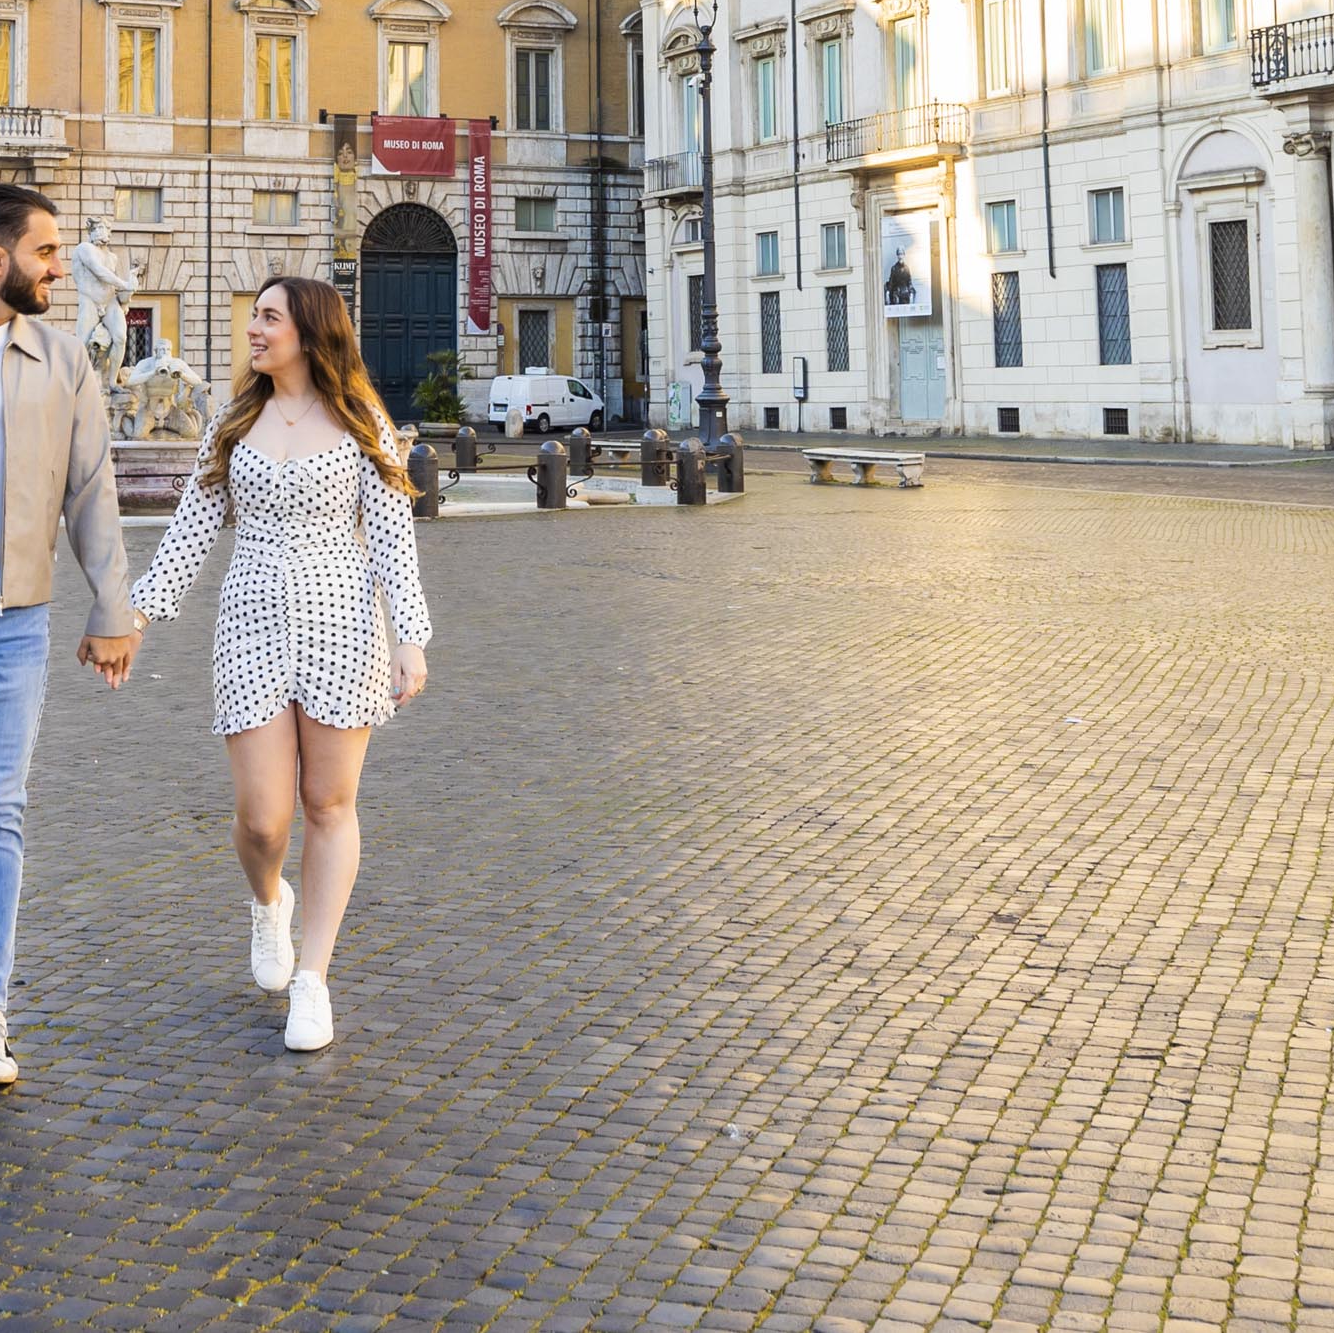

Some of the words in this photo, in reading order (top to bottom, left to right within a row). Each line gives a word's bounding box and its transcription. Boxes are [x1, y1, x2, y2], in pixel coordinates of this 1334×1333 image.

[383, 139, 410, 149] MUSEO
[411, 140, 420, 149] DI
[422, 141, 444, 150] ROMA
[473, 155, 486, 192] ROMA
[474, 196, 486, 209] DI
[473, 213, 486, 258] MUSEO
[334, 262, 356, 271] KLIMT
